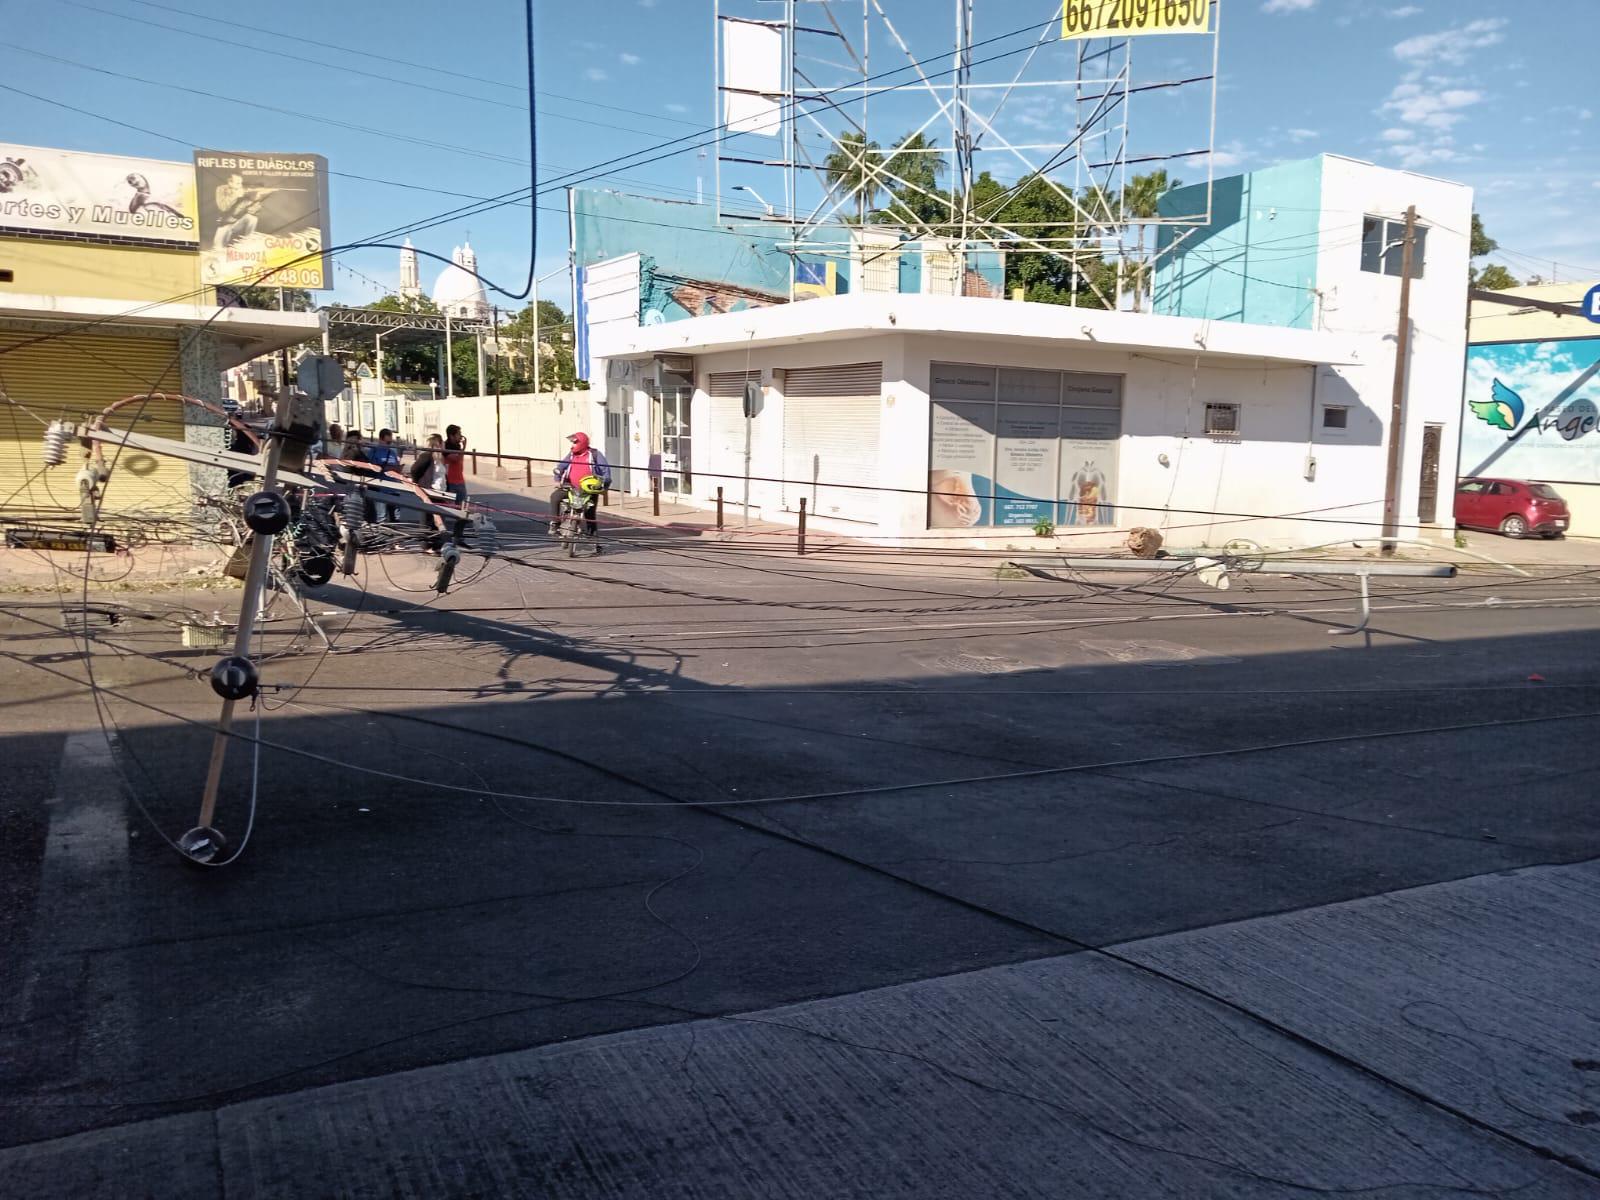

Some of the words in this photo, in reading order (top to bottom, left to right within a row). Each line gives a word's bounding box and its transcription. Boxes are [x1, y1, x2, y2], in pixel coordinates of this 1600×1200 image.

[197, 157, 236, 169] RIFLES
[239, 158, 255, 169] DE
[0, 198, 61, 219] rtes
[69, 206, 85, 224] y
[91, 205, 194, 230] Muelles
[265, 238, 303, 250] GAMO
[226, 249, 267, 264] MENDOZA
[241, 266, 254, 281] 7
[278, 269, 298, 285] 48
[301, 268, 321, 286] 06
